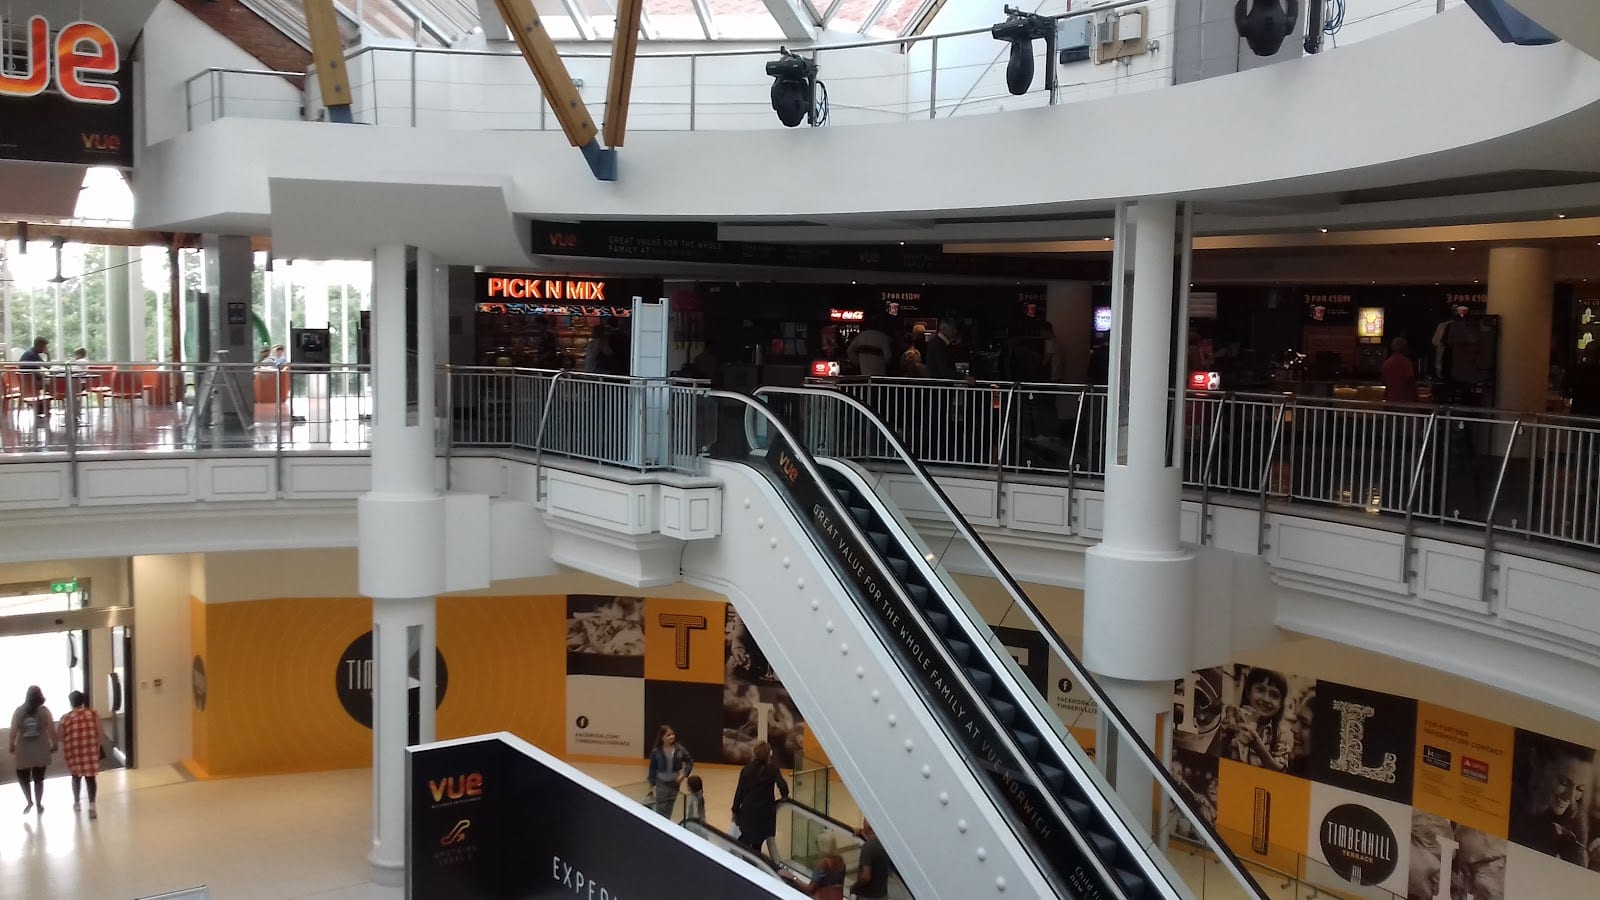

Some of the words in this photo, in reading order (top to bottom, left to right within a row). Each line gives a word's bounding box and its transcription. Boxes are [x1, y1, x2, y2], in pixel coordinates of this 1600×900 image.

[488, 277, 542, 299] PICK
[545, 279, 563, 299] N
[566, 280, 606, 301] MIX
[812, 503, 839, 541] GREAT
[839, 540, 865, 576] VALUE
[864, 575, 883, 600] FOR
[882, 599, 900, 628] THE
[900, 625, 930, 672] WHOLE
[930, 669, 966, 719] FAMILY
[965, 719, 981, 739] AT
[982, 739, 1004, 772] VUE
[1002, 771, 1051, 840] NORWICH
[1329, 699, 1398, 785] L
[1327, 821, 1391, 862] TIMBERHILL
[1342, 849, 1374, 864] TERRACE
